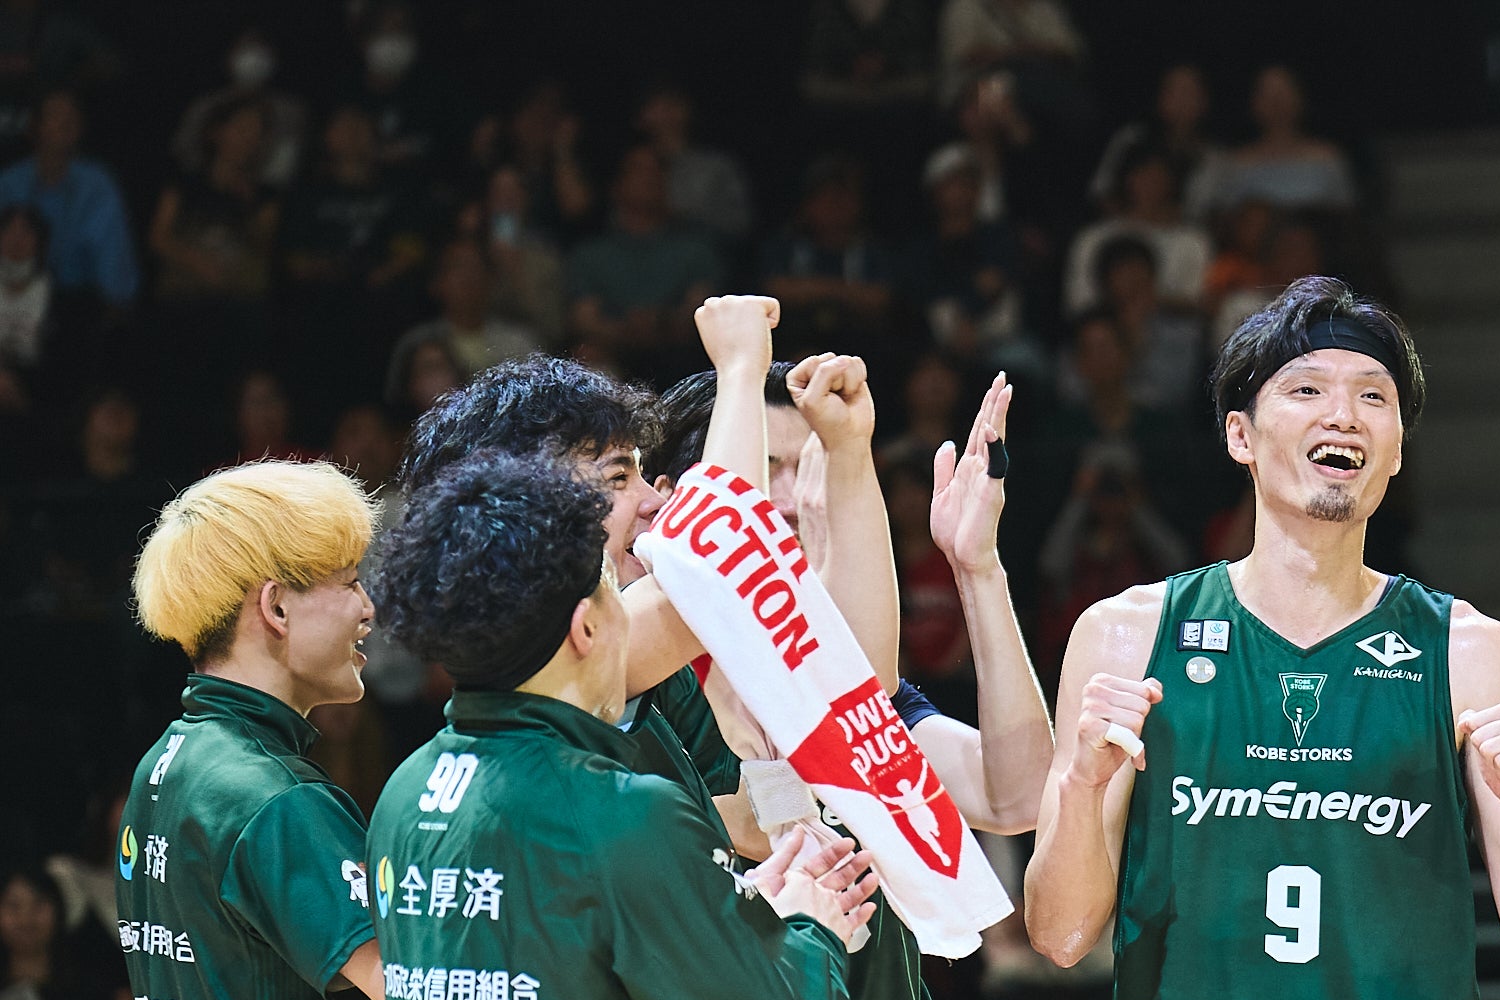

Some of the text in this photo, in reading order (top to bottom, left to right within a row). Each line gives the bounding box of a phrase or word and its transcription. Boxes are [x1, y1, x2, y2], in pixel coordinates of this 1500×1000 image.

[650, 485, 820, 672] UCTION
[1353, 666, 1423, 683] KAMIGUMI
[418, 752, 479, 813] 90
[1246, 744, 1353, 762] KOBE STORKS
[1171, 776, 1432, 838] SymEnergy
[396, 864, 504, 921] 全厚済
[1264, 864, 1322, 964] 9
